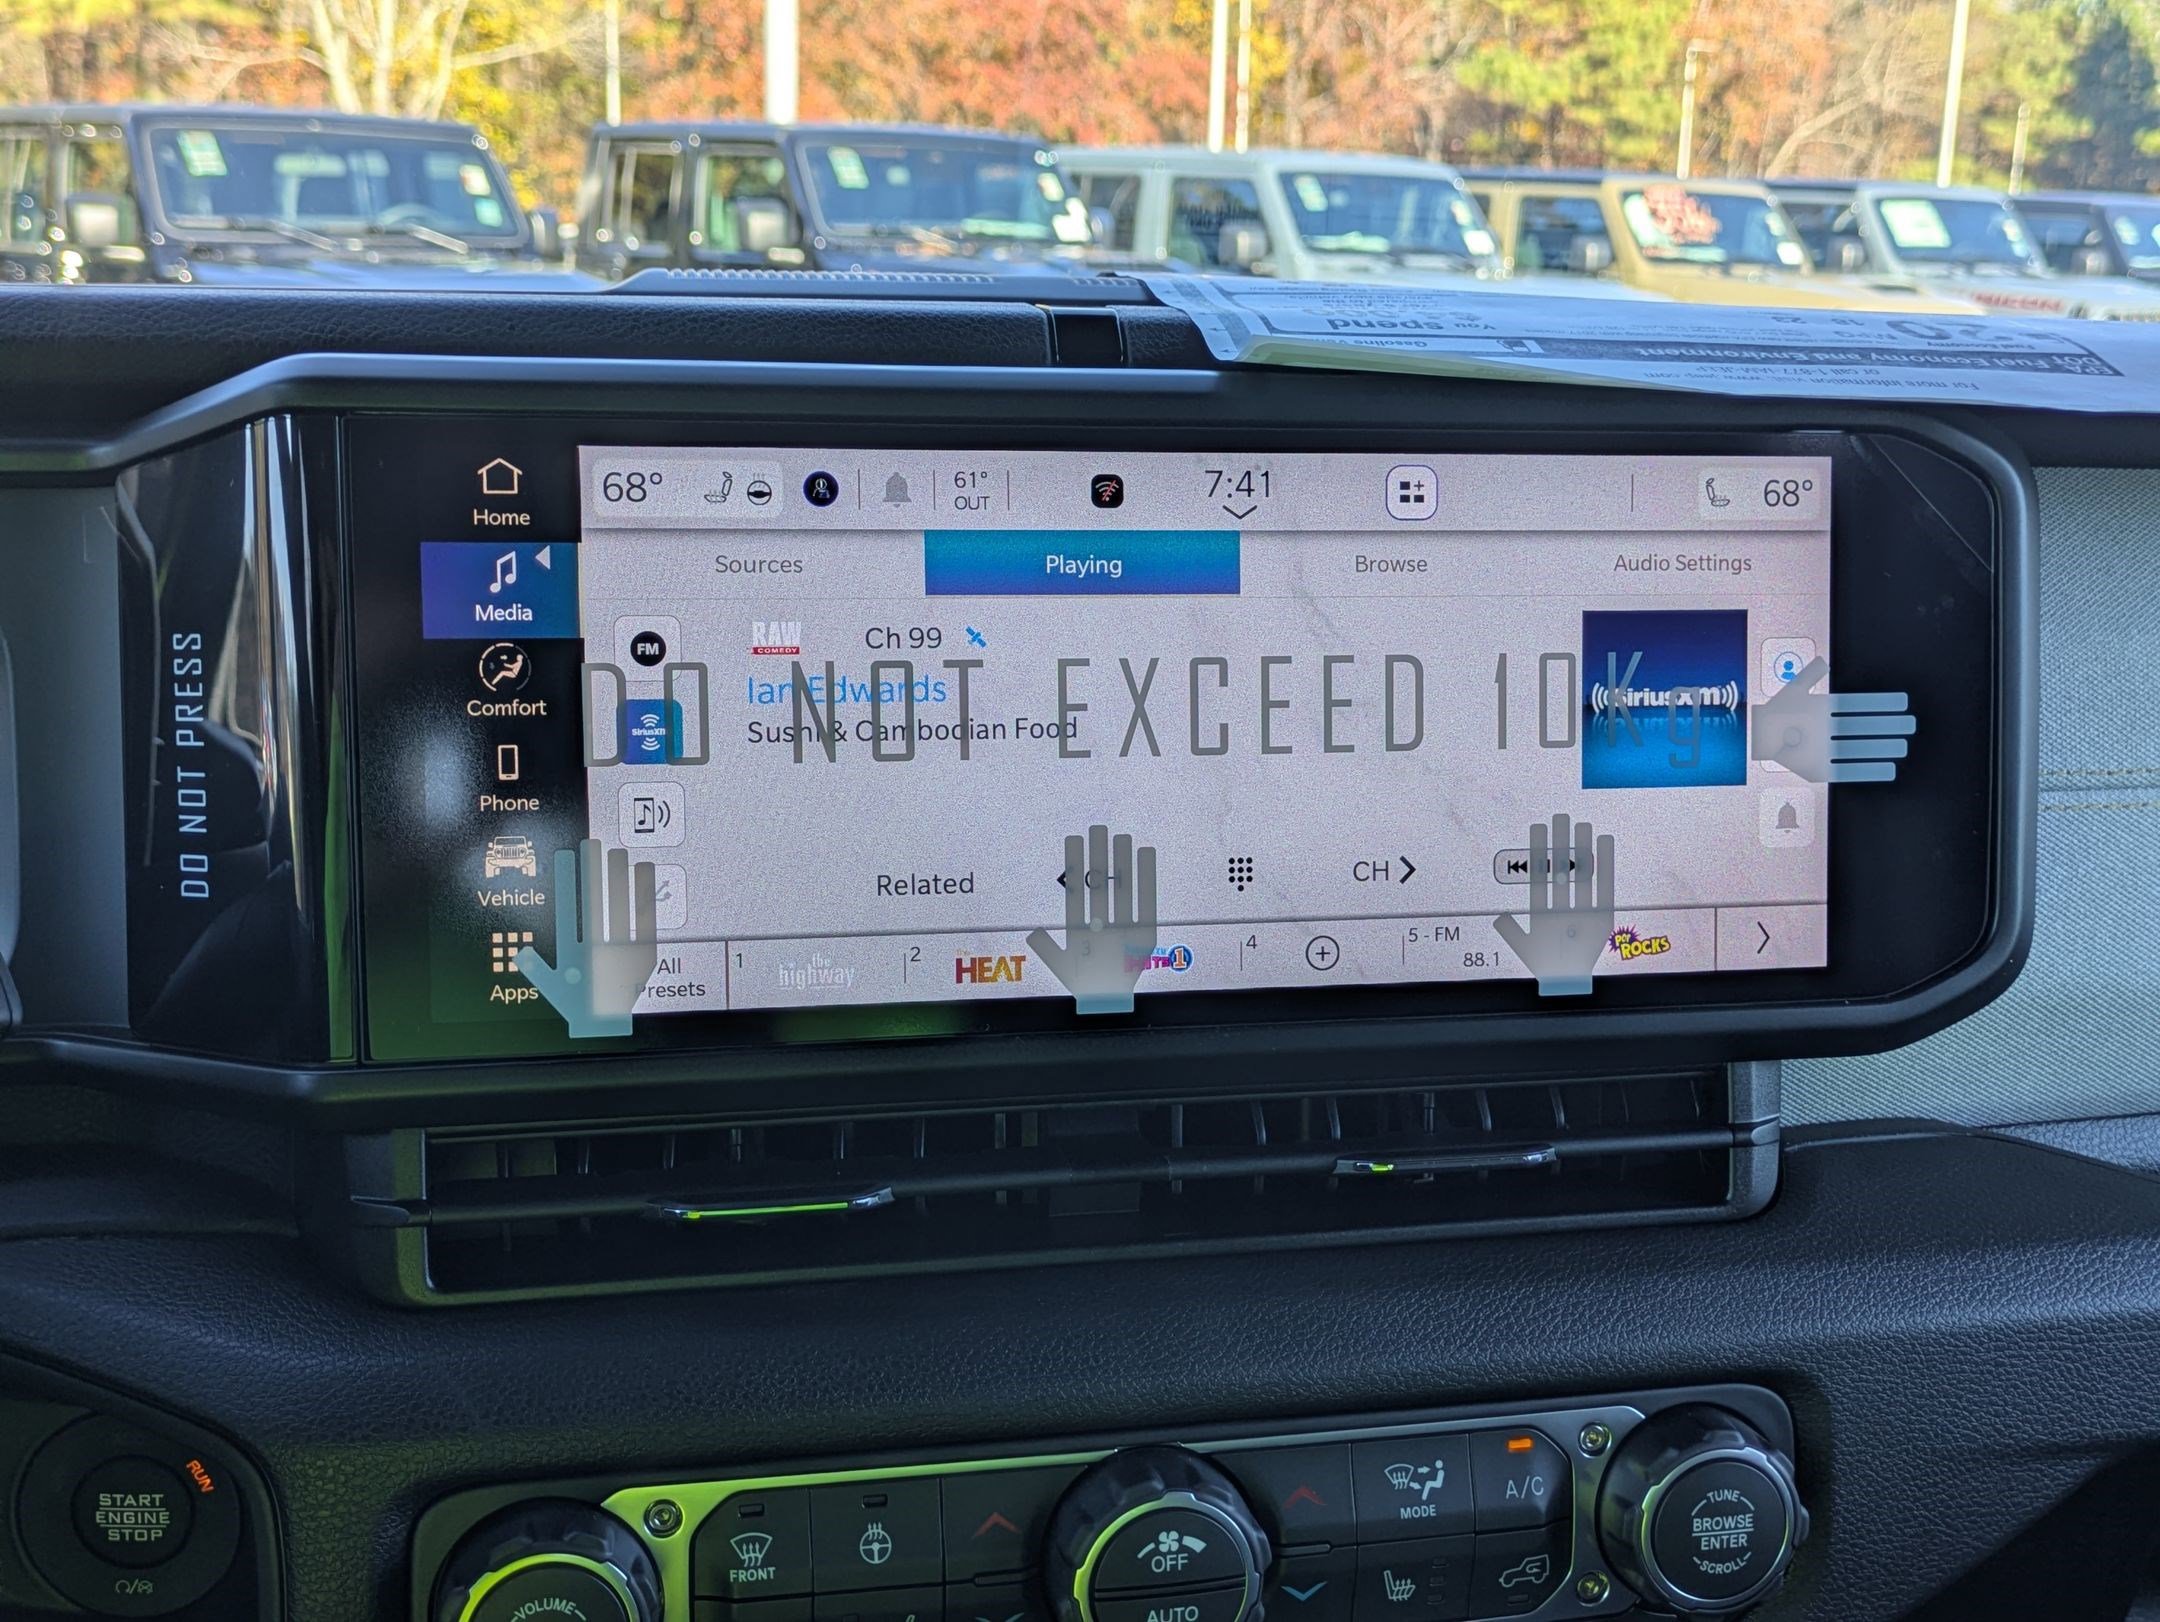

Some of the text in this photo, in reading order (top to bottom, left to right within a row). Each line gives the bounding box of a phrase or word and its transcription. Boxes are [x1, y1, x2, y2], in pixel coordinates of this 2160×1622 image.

[1327, 318, 1445, 331] spend
[1353, 339, 1429, 349] Gasoline
[1633, 347, 2052, 370] Fuel Economy and Environment
[2050, 354, 2100, 367] DOT
[2065, 365, 2114, 376] EPA
[1810, 377, 1903, 388] information
[602, 471, 663, 503] 68°
[954, 470, 988, 489] 61°
[1205, 469, 1271, 499] 7:41
[1764, 479, 1813, 507] 68°
[954, 495, 989, 511] OUT
[473, 509, 531, 527] Home
[715, 555, 803, 574] Sources
[1046, 554, 1122, 577] Playing
[1355, 555, 1428, 574] Browse
[1614, 554, 1752, 576] Audio Settings
[475, 603, 533, 622] Media
[752, 621, 800, 645] RAW
[865, 627, 942, 649] Ch 99
[637, 643, 659, 655] FM
[748, 674, 947, 704] Ian Edwards
[467, 698, 547, 717] Comfort
[580, 661, 710, 767] DO
[793, 659, 984, 763] NOT
[1057, 654, 1424, 758] EXCEED
[1015, 716, 1077, 739] Food
[173, 633, 209, 898] DO NOT PRESS
[480, 794, 540, 813] Phone
[1353, 861, 1390, 882] CH
[877, 872, 975, 897] Related
[477, 889, 545, 907] Vehicle
[1246, 934, 1257, 950] 4
[1409, 927, 1419, 943] 5
[1435, 926, 1461, 942] FM
[910, 946, 921, 962] 2
[1621, 936, 1671, 960] ROCKS
[657, 958, 681, 975] All
[736, 953, 743, 968] 1
[1463, 952, 1500, 967] 88.1
[778, 963, 855, 989] highway
[955, 956, 1026, 983] HEAT
[489, 983, 539, 1004] Apps
[186, 1459, 214, 1493] RUN
[1506, 1475, 1544, 1499] A/C
[1706, 1489, 1740, 1504] TUNE
[98, 1493, 164, 1507] START
[96, 1510, 171, 1526] ENGINE
[1400, 1504, 1437, 1519] MODE
[1692, 1512, 1754, 1532] BROWSE
[107, 1528, 163, 1542] STOP
[1700, 1533, 1748, 1551] ENTER
[1150, 1553, 1189, 1574] OFF
[1699, 1555, 1747, 1575] SCROLL
[729, 1566, 776, 1584] FRONT
[514, 1599, 578, 1619] VOLUME
[1146, 1606, 1200, 1622] AUTO
